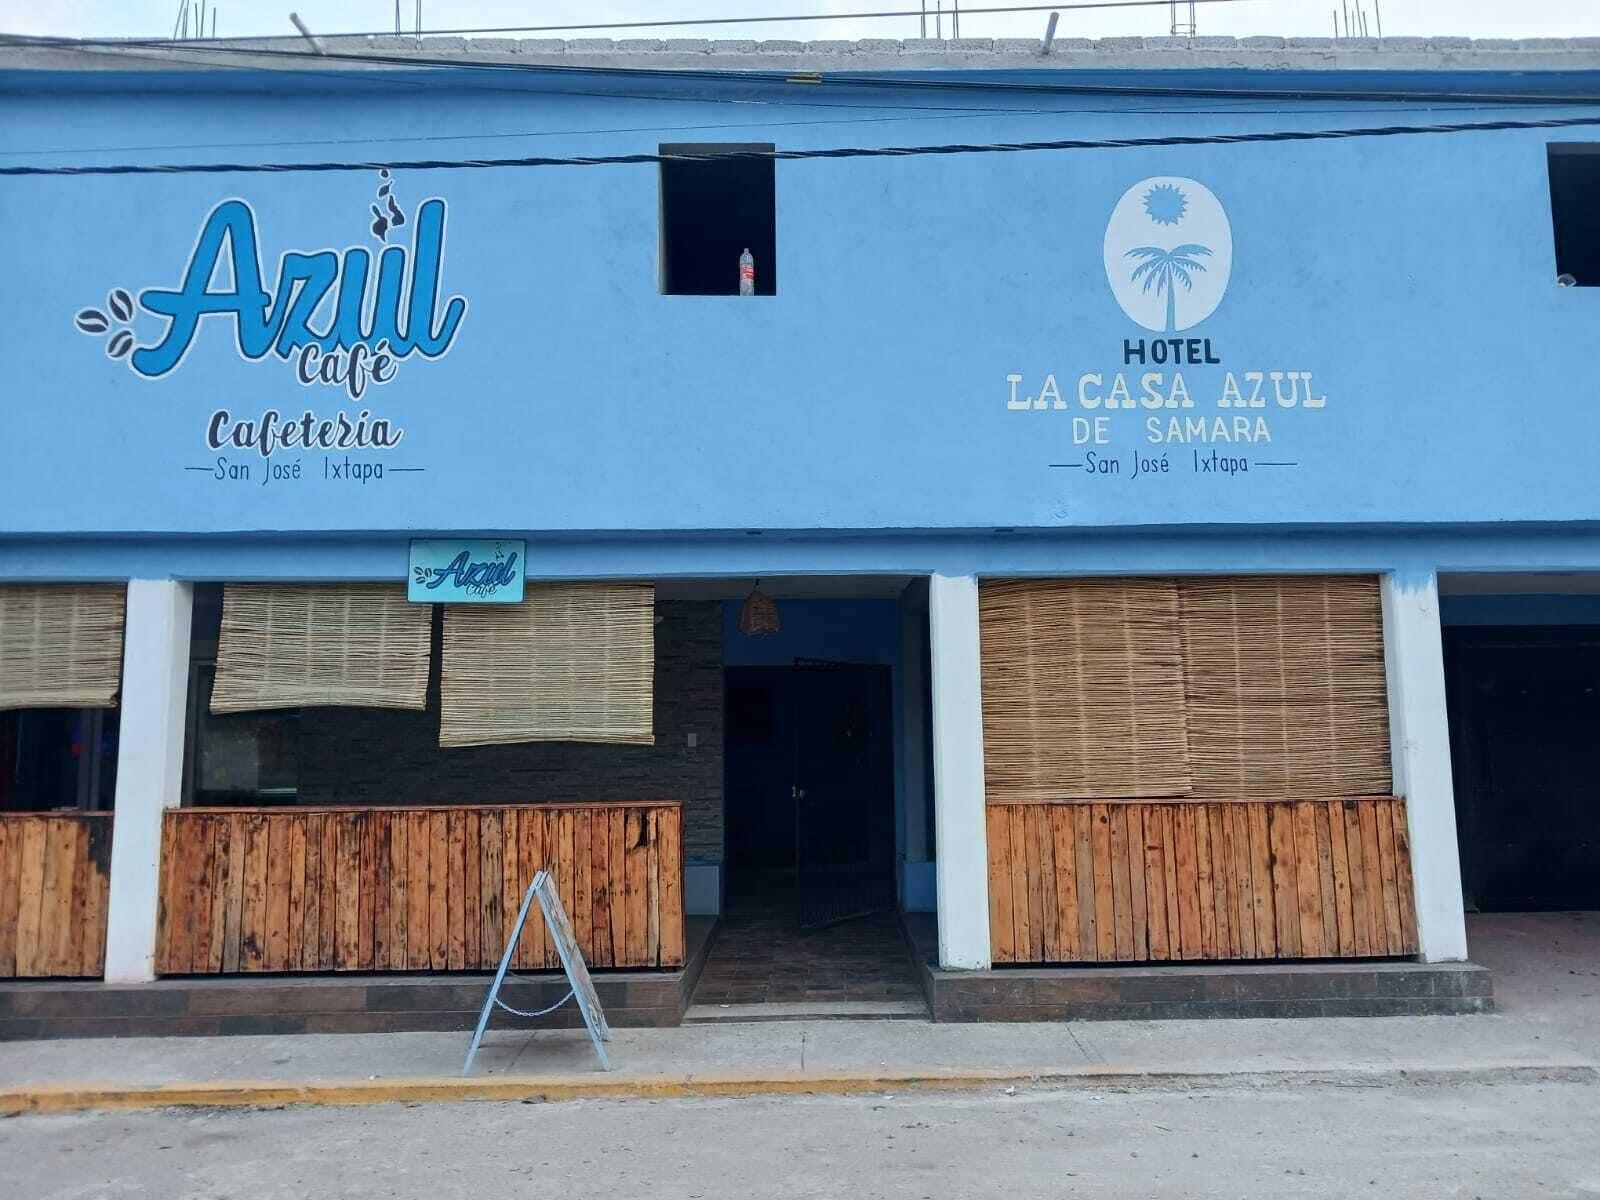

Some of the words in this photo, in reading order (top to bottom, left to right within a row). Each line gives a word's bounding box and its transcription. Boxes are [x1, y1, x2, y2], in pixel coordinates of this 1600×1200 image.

[131, 198, 467, 377] Azul
[297, 339, 398, 399] Café
[1123, 338, 1221, 365] HOTEL
[1006, 374, 1068, 410] LA
[1078, 372, 1195, 409] CASA
[1216, 371, 1328, 408] AZUL
[1071, 416, 1110, 445] DE
[1146, 415, 1272, 444] SAMARA
[213, 456, 250, 480] San
[261, 457, 302, 486] José
[323, 455, 384, 485] Ixtapa
[1085, 451, 1120, 474] San
[1130, 450, 1170, 480] José
[1193, 449, 1249, 476] Ixtapa
[425, 550, 518, 590] Azul
